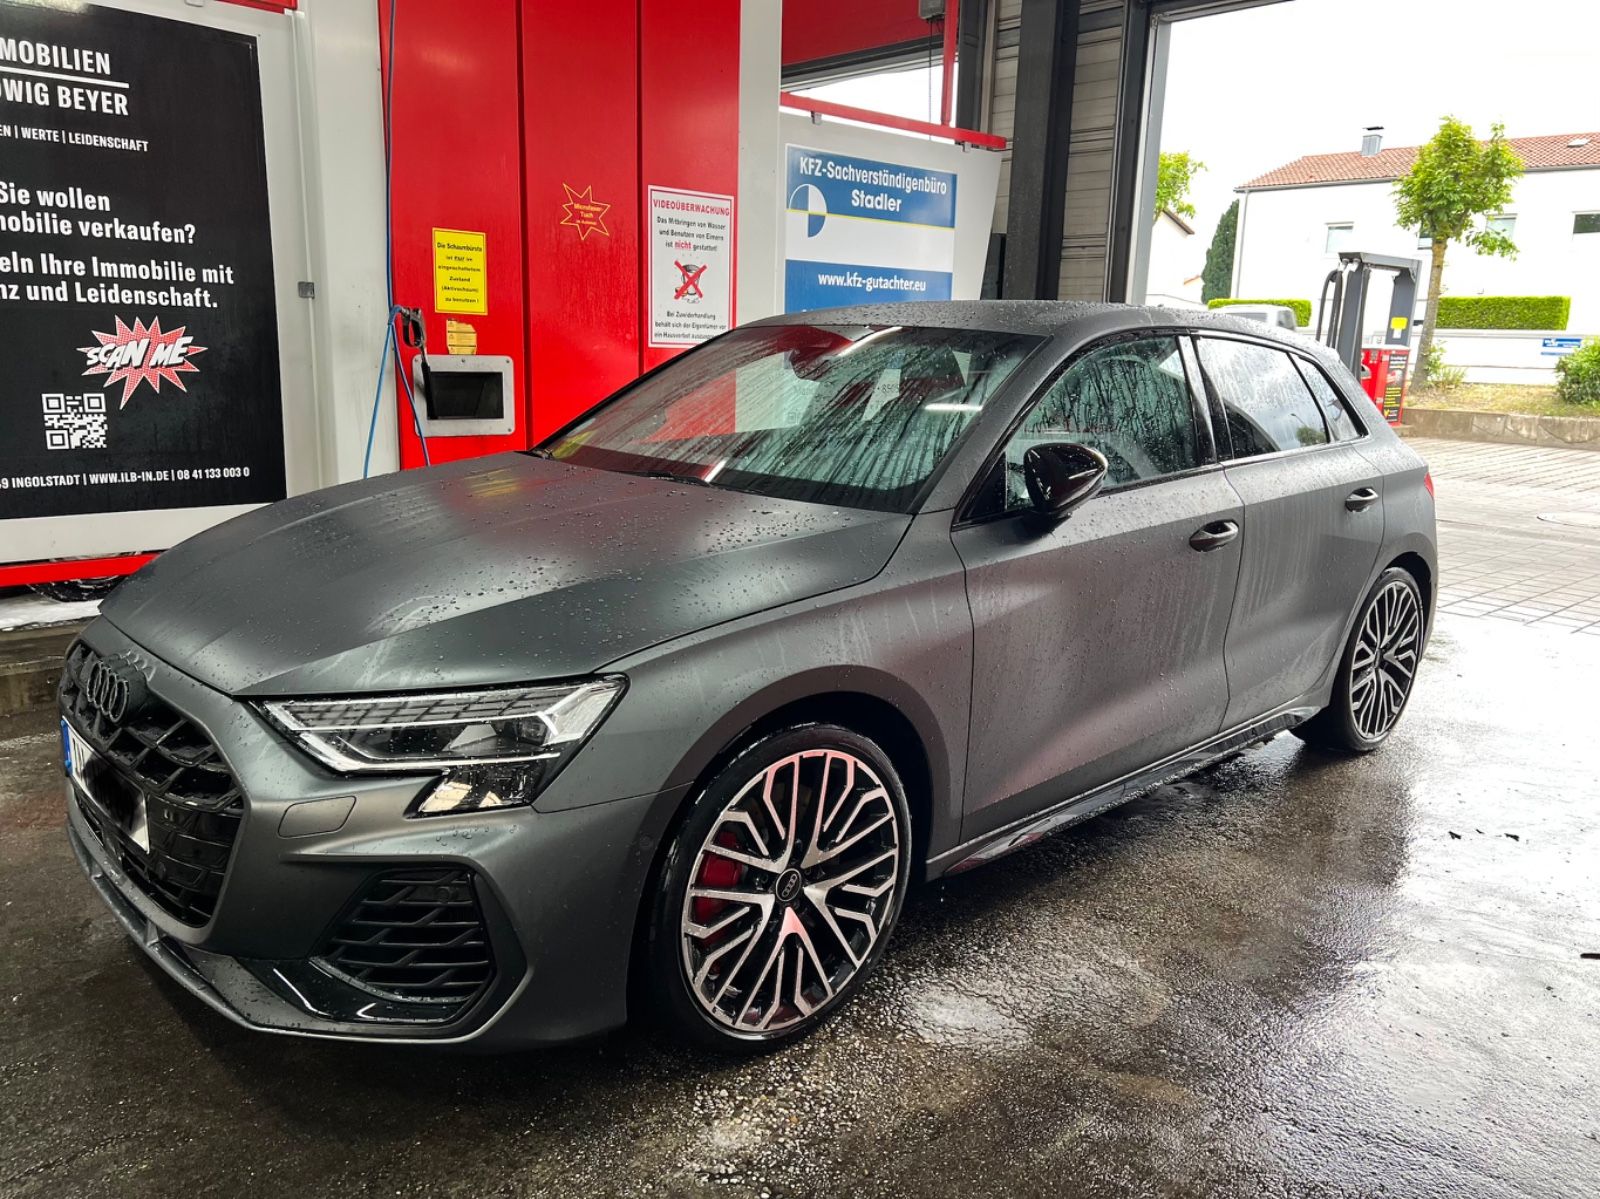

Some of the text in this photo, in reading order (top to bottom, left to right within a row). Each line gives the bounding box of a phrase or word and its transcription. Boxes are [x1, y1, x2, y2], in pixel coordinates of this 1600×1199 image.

[0, 37, 111, 75] MOBILIEN
[0, 78, 129, 116] WIG BEYER
[21, 126, 60, 143] WERTE
[68, 132, 149, 152] LEIDENSCHAFT
[799, 156, 947, 195] KFZ-Sachverständigenbüro
[0, 181, 110, 212] Sie wollen
[653, 199, 730, 216] VIDEOÜBERWACHUNG
[851, 189, 902, 212] Stadler
[78, 217, 196, 244] verkaufen?
[656, 216, 668, 224] Das
[668, 217, 696, 228] Mitbringen
[670, 229, 695, 239] Benutzen
[674, 241, 692, 249] nicht
[40, 252, 86, 277] Ihre
[92, 256, 196, 281] Immobilie
[202, 265, 235, 285] mit
[818, 271, 927, 292] www.kfz-gutachter.eu
[26, 281, 69, 302] und
[75, 282, 218, 308] Leidenschaft.
[86, 336, 194, 369] SCAN ME
[11, 474, 81, 489] INGOLSTADT
[89, 470, 170, 485] WWW.ILB-IN.DE
[177, 469, 190, 480] 08
[192, 469, 203, 479] 41
[204, 467, 221, 479] 133
[223, 467, 242, 478] 003
[243, 466, 250, 477] 0
